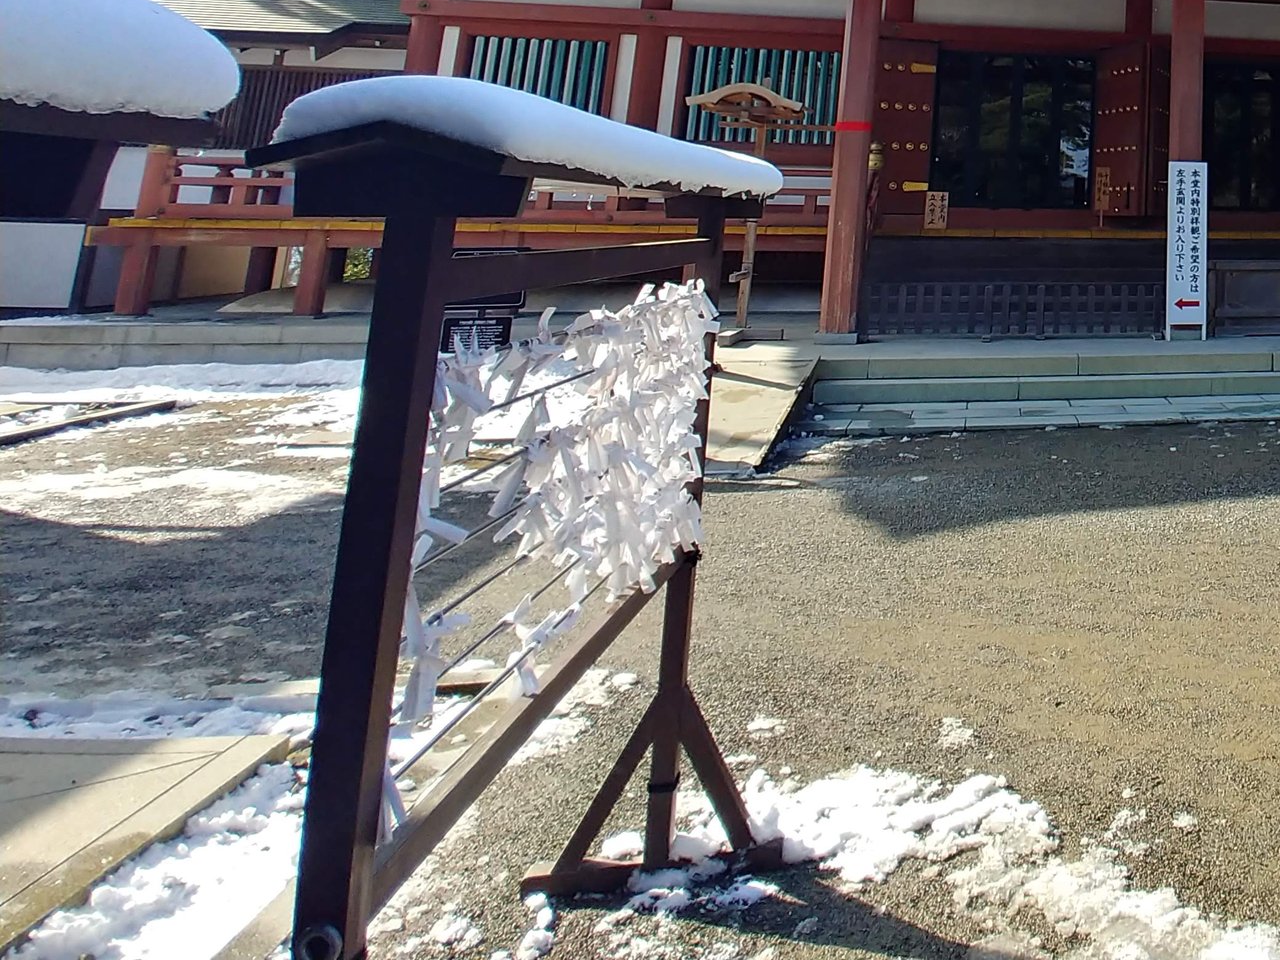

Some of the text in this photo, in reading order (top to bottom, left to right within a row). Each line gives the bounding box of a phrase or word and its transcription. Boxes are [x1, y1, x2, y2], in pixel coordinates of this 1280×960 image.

[1175, 168, 1186, 281] 左手玄関よりお入り下さい
[1189, 169, 1201, 293] 本堂内特別拝観ご希望の方は
